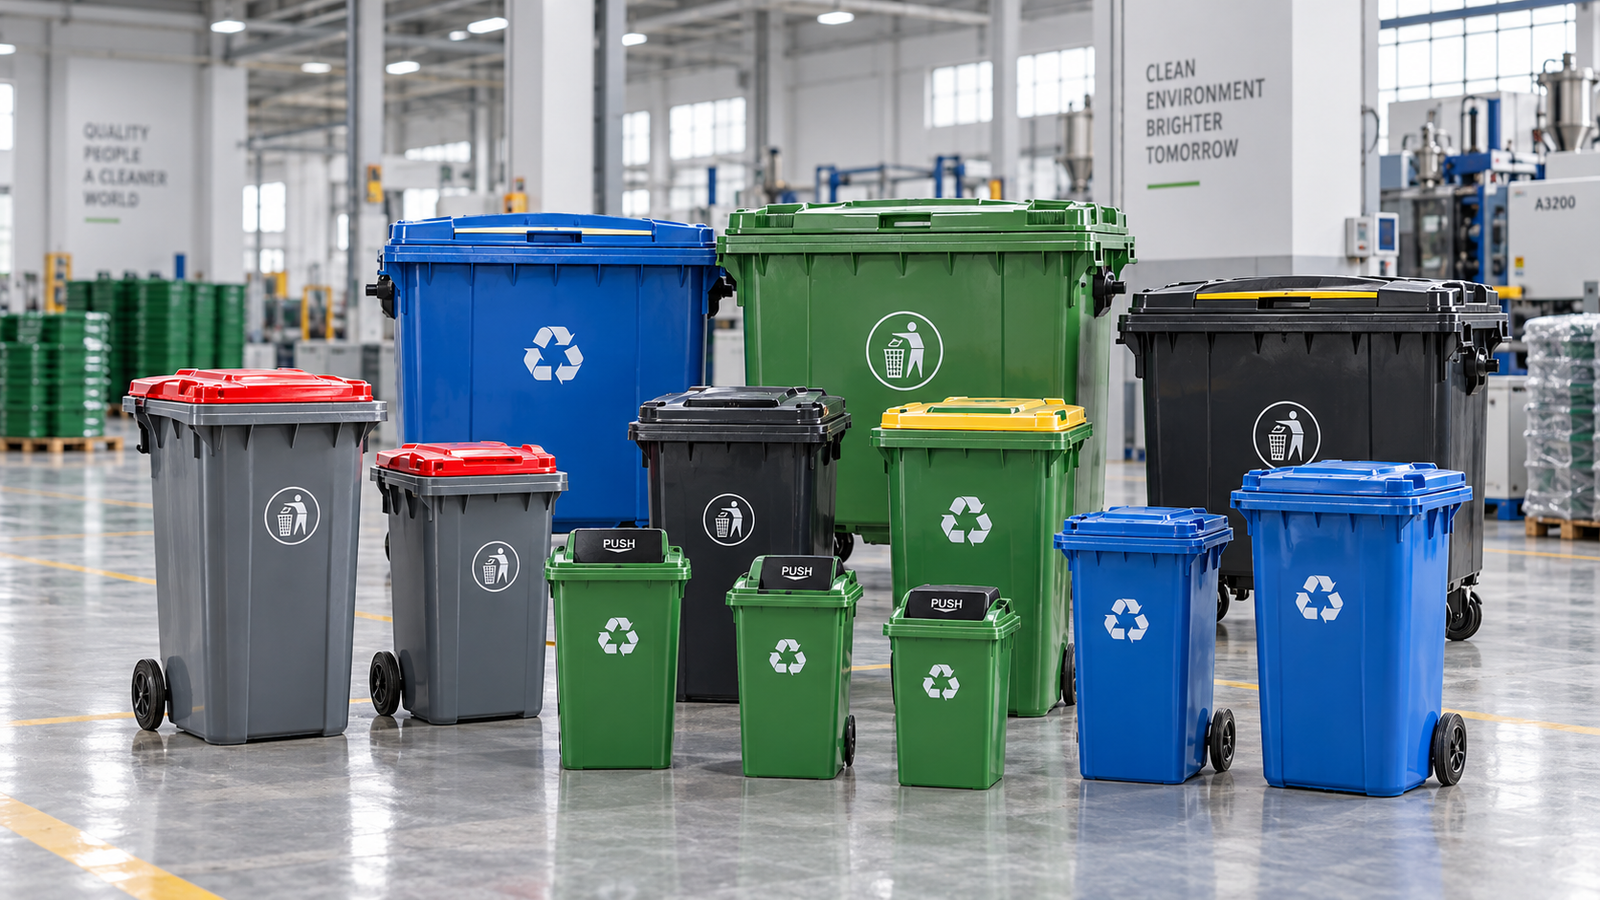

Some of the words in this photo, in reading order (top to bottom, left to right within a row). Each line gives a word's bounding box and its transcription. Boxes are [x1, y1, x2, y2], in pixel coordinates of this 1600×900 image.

[1146, 58, 1196, 82] CLEAN
[1146, 78, 1266, 109] ENVIRONMENT
[84, 122, 150, 141] QUALITY
[1146, 111, 1223, 137] BRIGHTER
[84, 145, 141, 164] PEOPLE
[1146, 138, 1239, 164] TOMORROW
[83, 168, 95, 183] A
[99, 168, 168, 187] CLEANER
[83, 190, 140, 208] WORLD
[1534, 195, 1576, 211] A3200
[603, 538, 635, 549] PUSH
[781, 566, 813, 577] PUSH
[931, 598, 962, 609] PUSH
